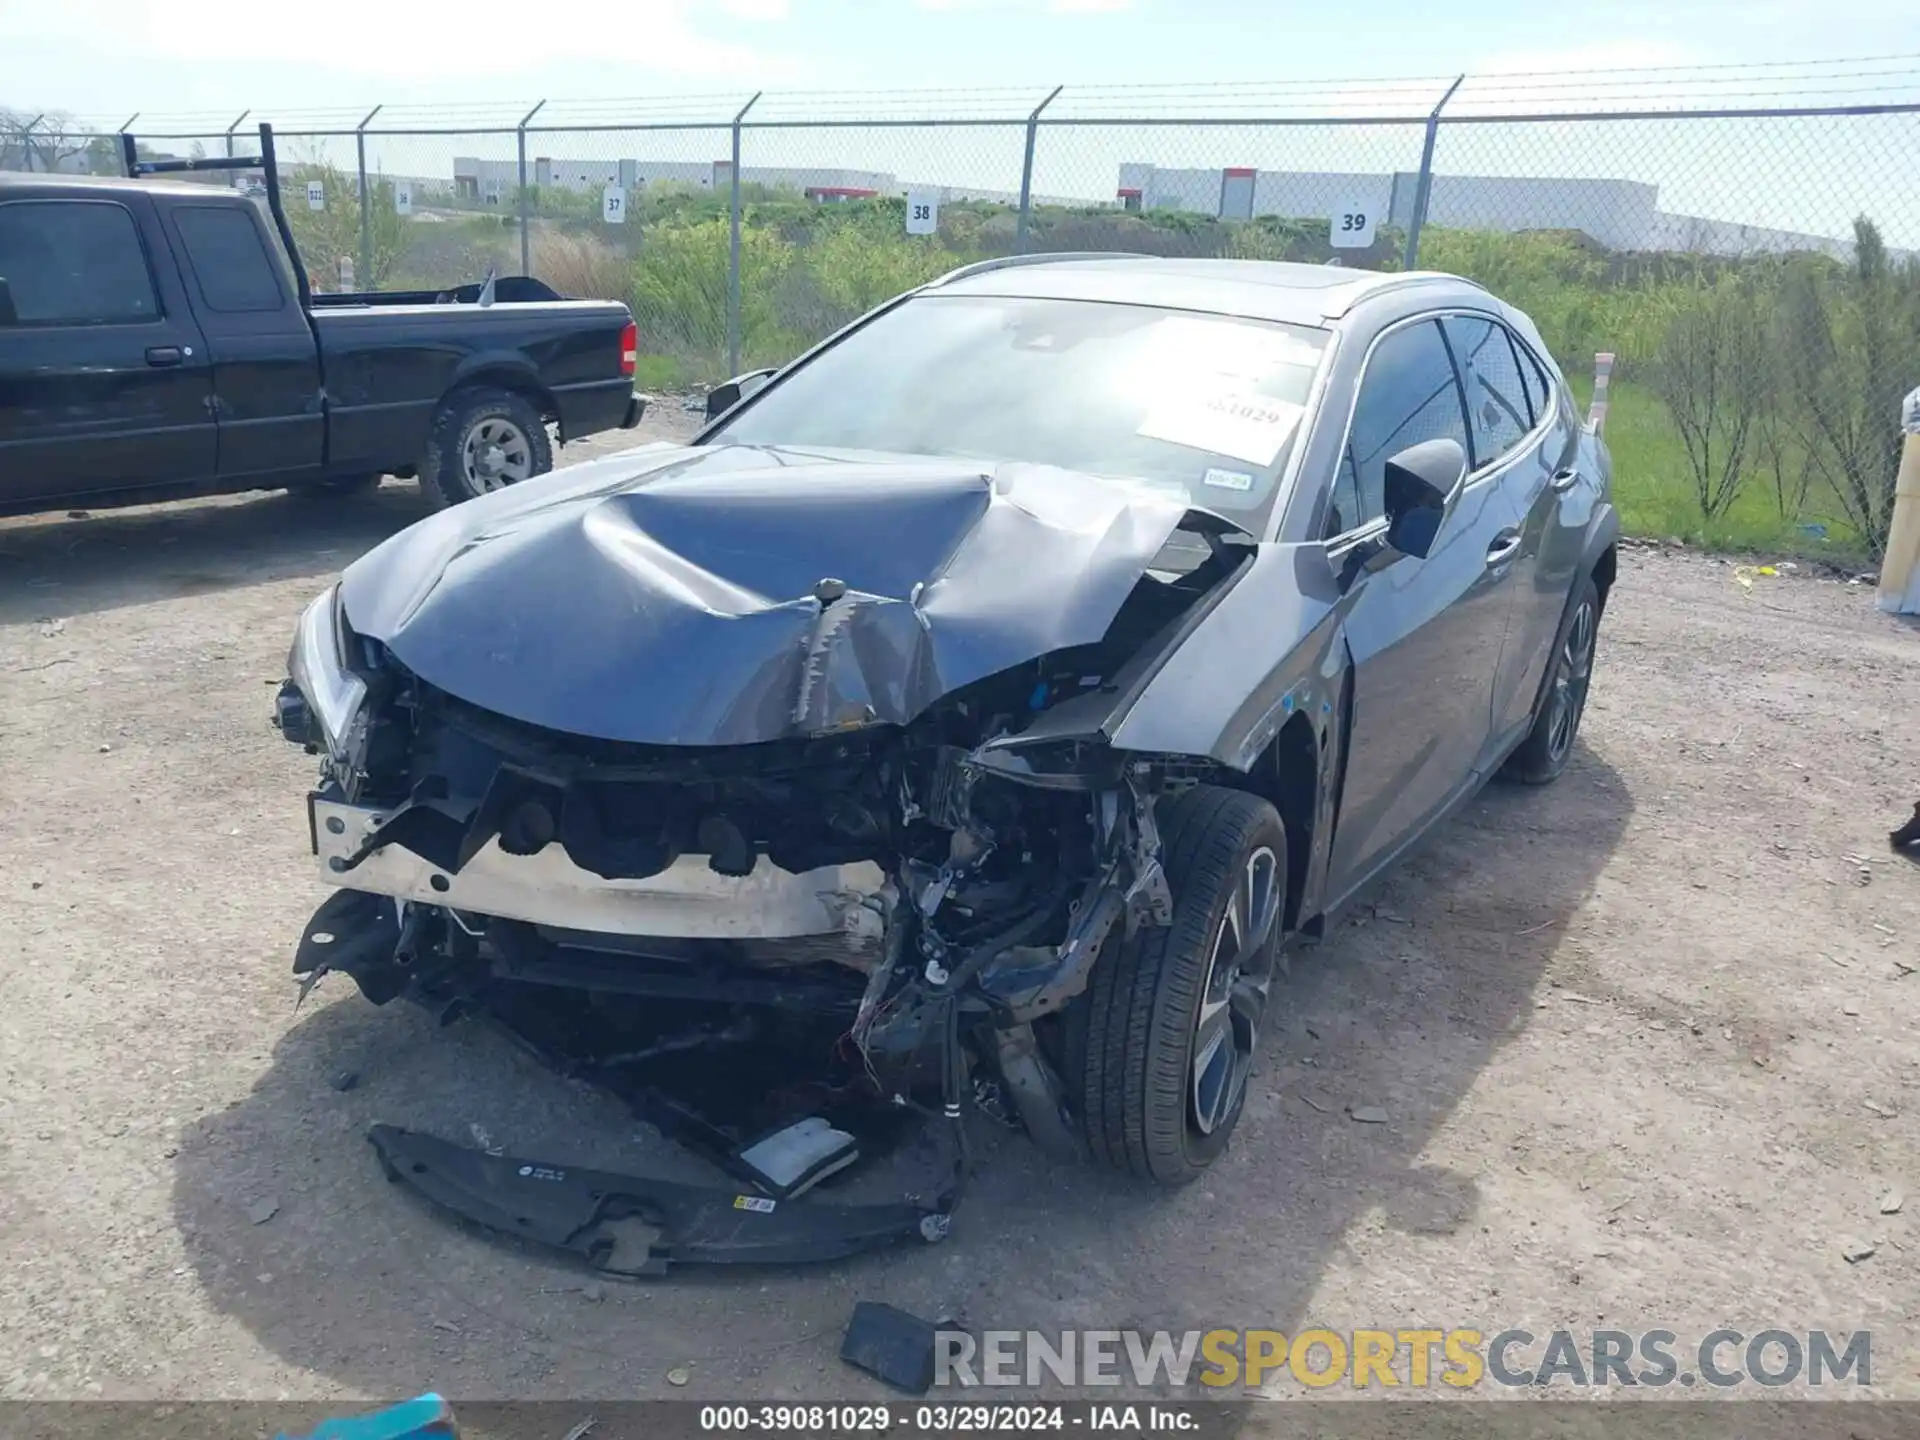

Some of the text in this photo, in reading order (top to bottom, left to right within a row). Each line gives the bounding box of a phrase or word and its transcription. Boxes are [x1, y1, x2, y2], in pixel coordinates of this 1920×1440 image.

[608, 198, 620, 211] 37
[913, 205, 930, 220] 38
[1341, 213, 1366, 232] 39
